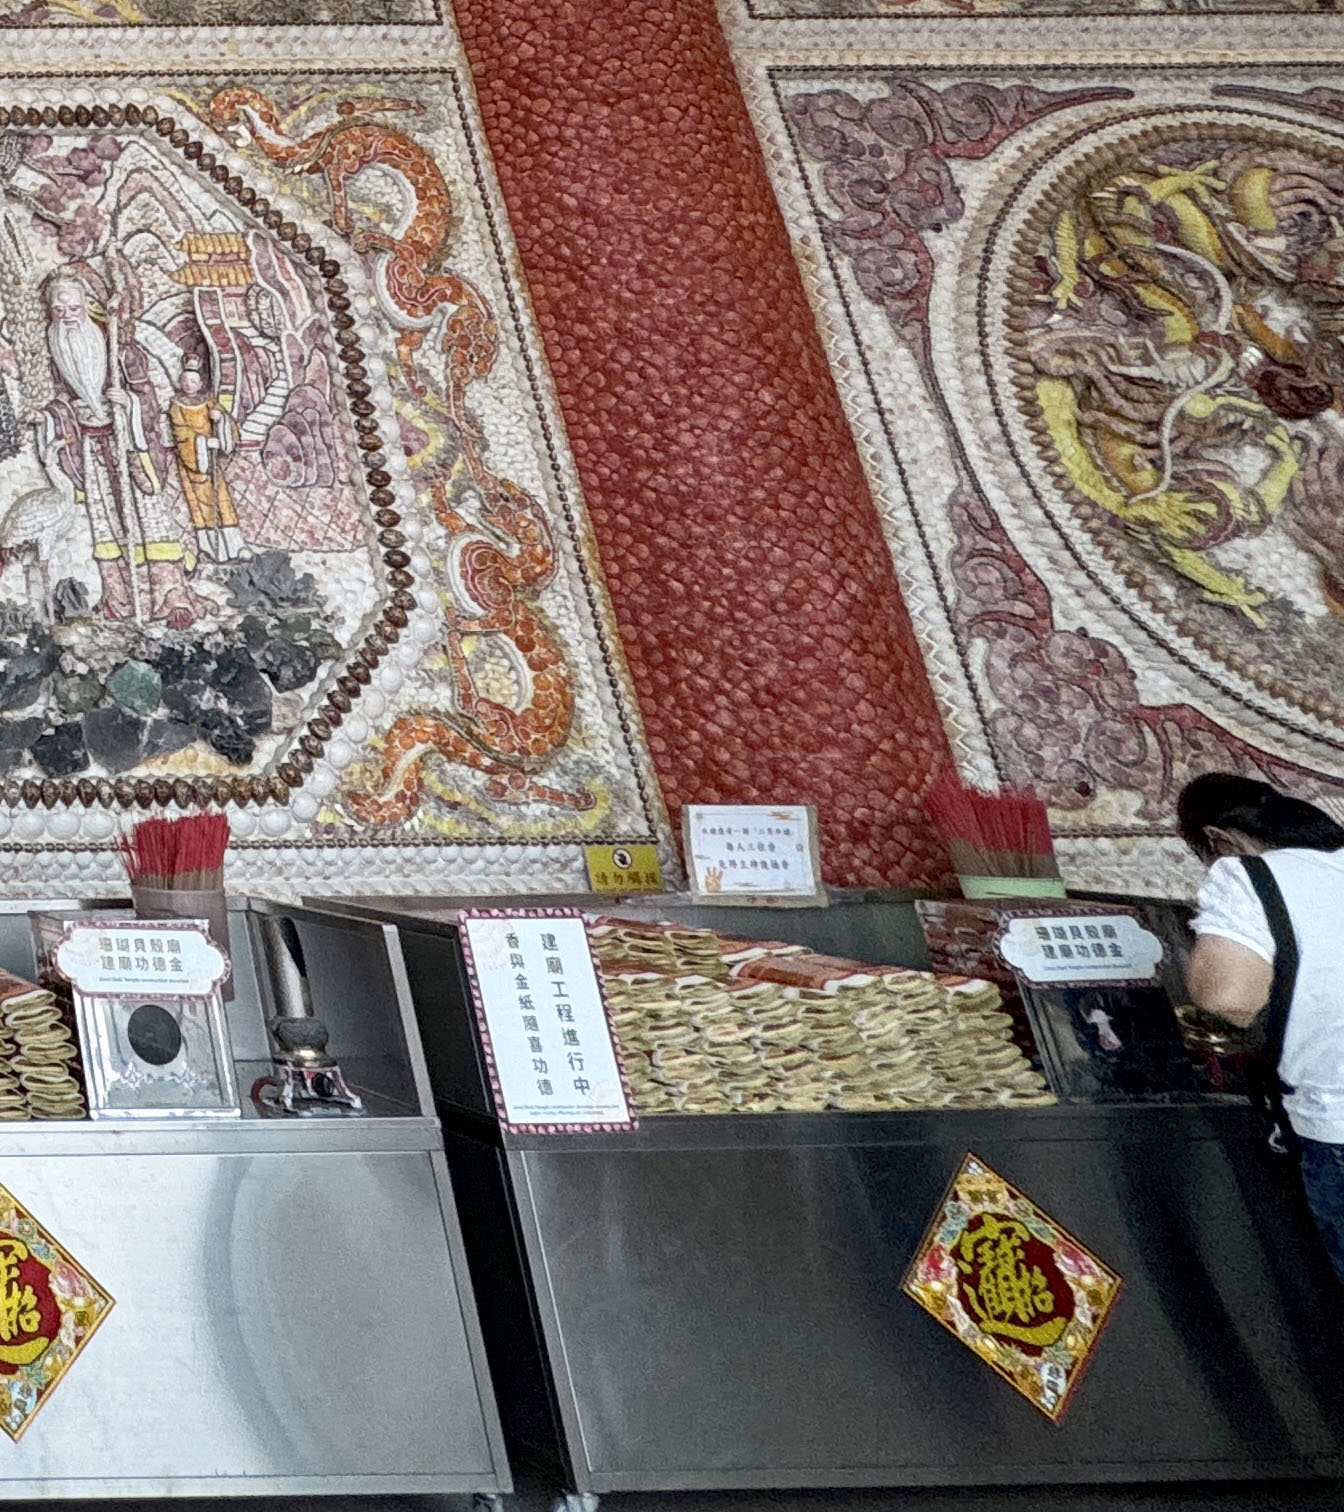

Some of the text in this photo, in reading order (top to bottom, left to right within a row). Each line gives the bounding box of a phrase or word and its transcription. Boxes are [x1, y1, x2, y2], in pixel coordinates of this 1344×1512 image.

[505, 932, 554, 1096] 香與金紙隨喜功德
[539, 933, 591, 1096] 建廟工程進行中
